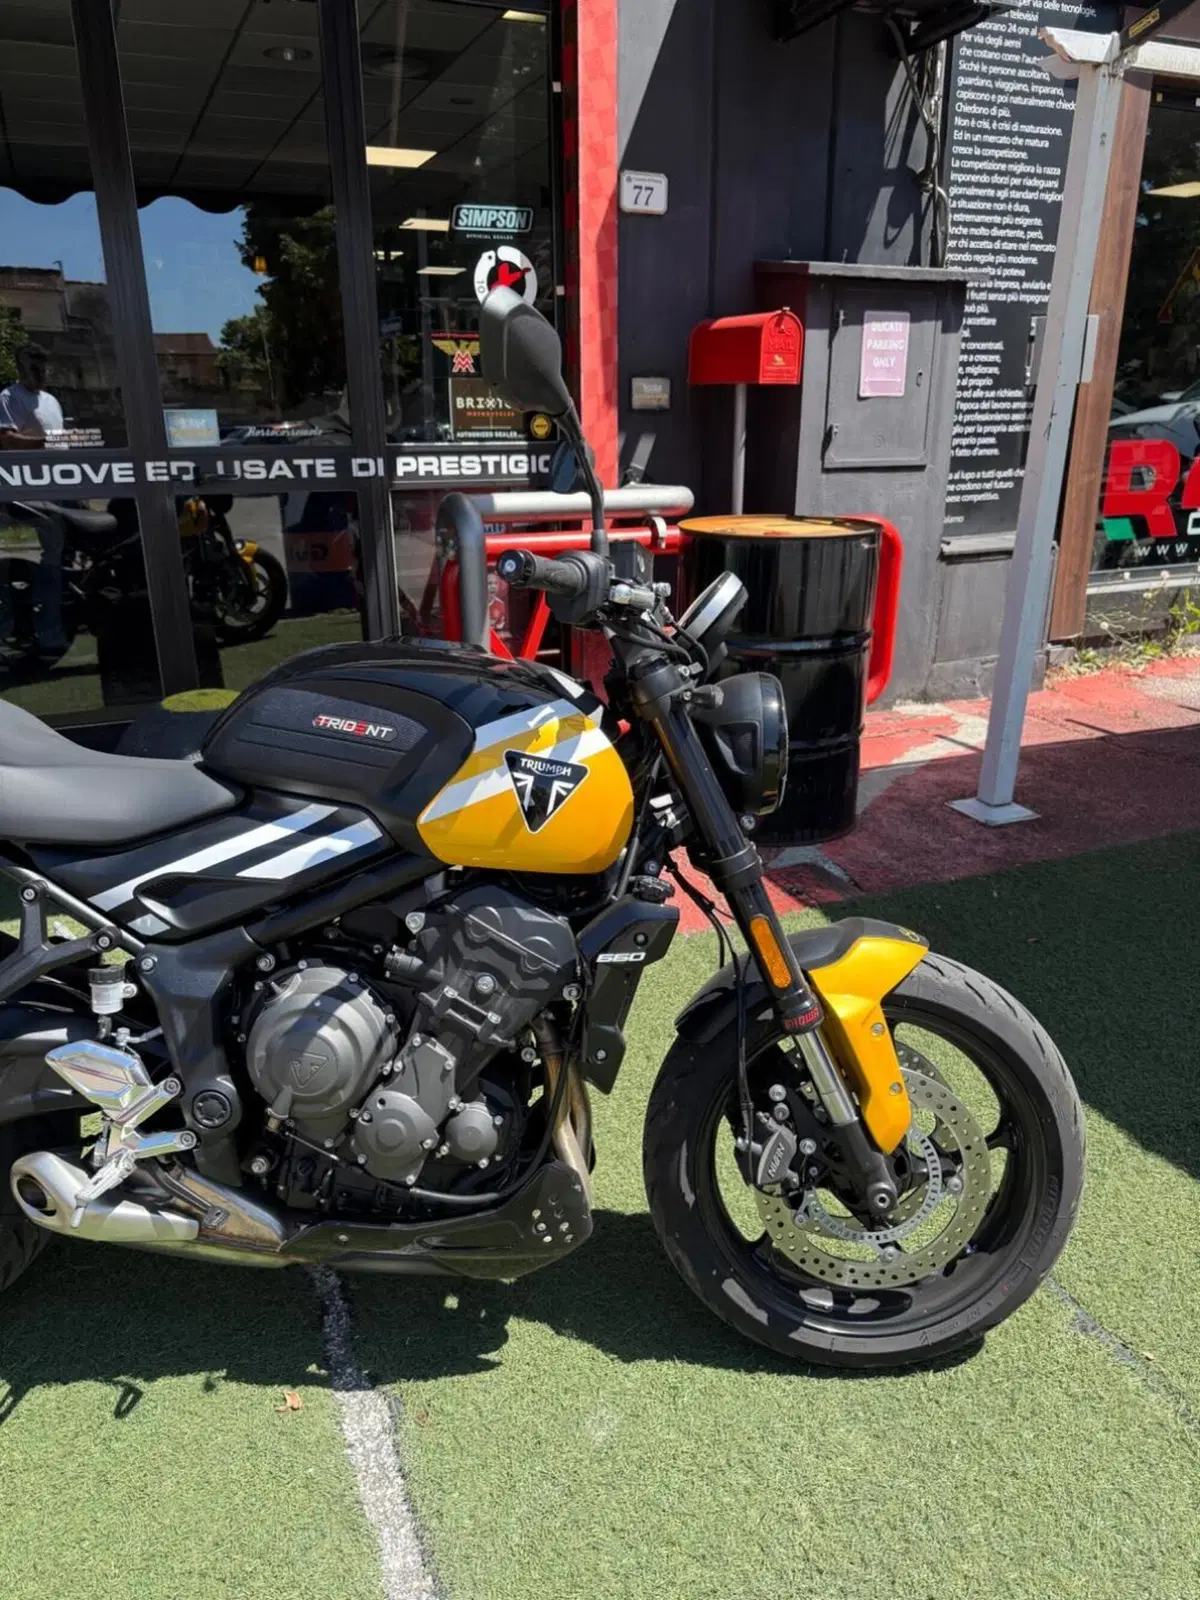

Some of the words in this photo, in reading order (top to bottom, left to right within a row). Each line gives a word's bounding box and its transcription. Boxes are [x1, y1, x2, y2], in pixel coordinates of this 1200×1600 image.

[1033, 0, 1042, 8] via
[1043, 0, 1060, 11] delle
[1007, 23, 1017, 33] 24
[1018, 26, 1029, 35] ore
[960, 31, 972, 41] Per
[973, 33, 984, 43] via
[985, 33, 1002, 48] degli
[960, 46, 972, 56] che
[974, 49, 1000, 60] costano
[1002, 53, 1020, 62] come
[981, 62, 988, 72] le
[989, 65, 1016, 75] persone
[997, 94, 1009, 104] poi
[955, 102, 989, 115] Chiedono
[990, 106, 997, 115] di
[954, 116, 970, 127] Non
[1012, 122, 1019, 131] di
[953, 130, 962, 140] Ed
[964, 130, 970, 140] in
[972, 133, 981, 141] un
[983, 134, 1010, 144] mercato
[1011, 136, 1024, 146] che
[1024, 139, 1049, 148] matura
[952, 146, 973, 155] cresce
[974, 145, 980, 156] la
[951, 157, 960, 168] La
[961, 159, 1006, 171] competizione
[1008, 162, 1035, 174] migliora
[1036, 163, 1042, 174] la
[1043, 166, 1061, 175] razza
[1010, 177, 1021, 187] per
[633, 185, 654, 206] 77
[996, 188, 1009, 199] agli
[1010, 188, 1039, 200] standard
[958, 200, 992, 210] situazione
[458, 208, 527, 228] SIMPSON
[970, 226, 989, 236] molto
[958, 238, 968, 248] chi
[994, 240, 1001, 250] di
[1002, 241, 1017, 250] stare
[1018, 242, 1029, 250] nel
[1030, 244, 1056, 252] mercato
[973, 253, 995, 264] regole
[1019, 292, 1050, 304] impegnar
[871, 322, 903, 332] DUCATI
[867, 339, 905, 351] PARKING
[873, 356, 896, 368] ONLY
[456, 396, 511, 409] BRIXT
[0, 462, 136, 486] NUOVE
[216, 458, 337, 480] USATE
[351, 458, 384, 478] DI
[312, 714, 393, 738] TRIDENT
[520, 758, 572, 777] TRIUMPH
[596, 951, 646, 963] 660
